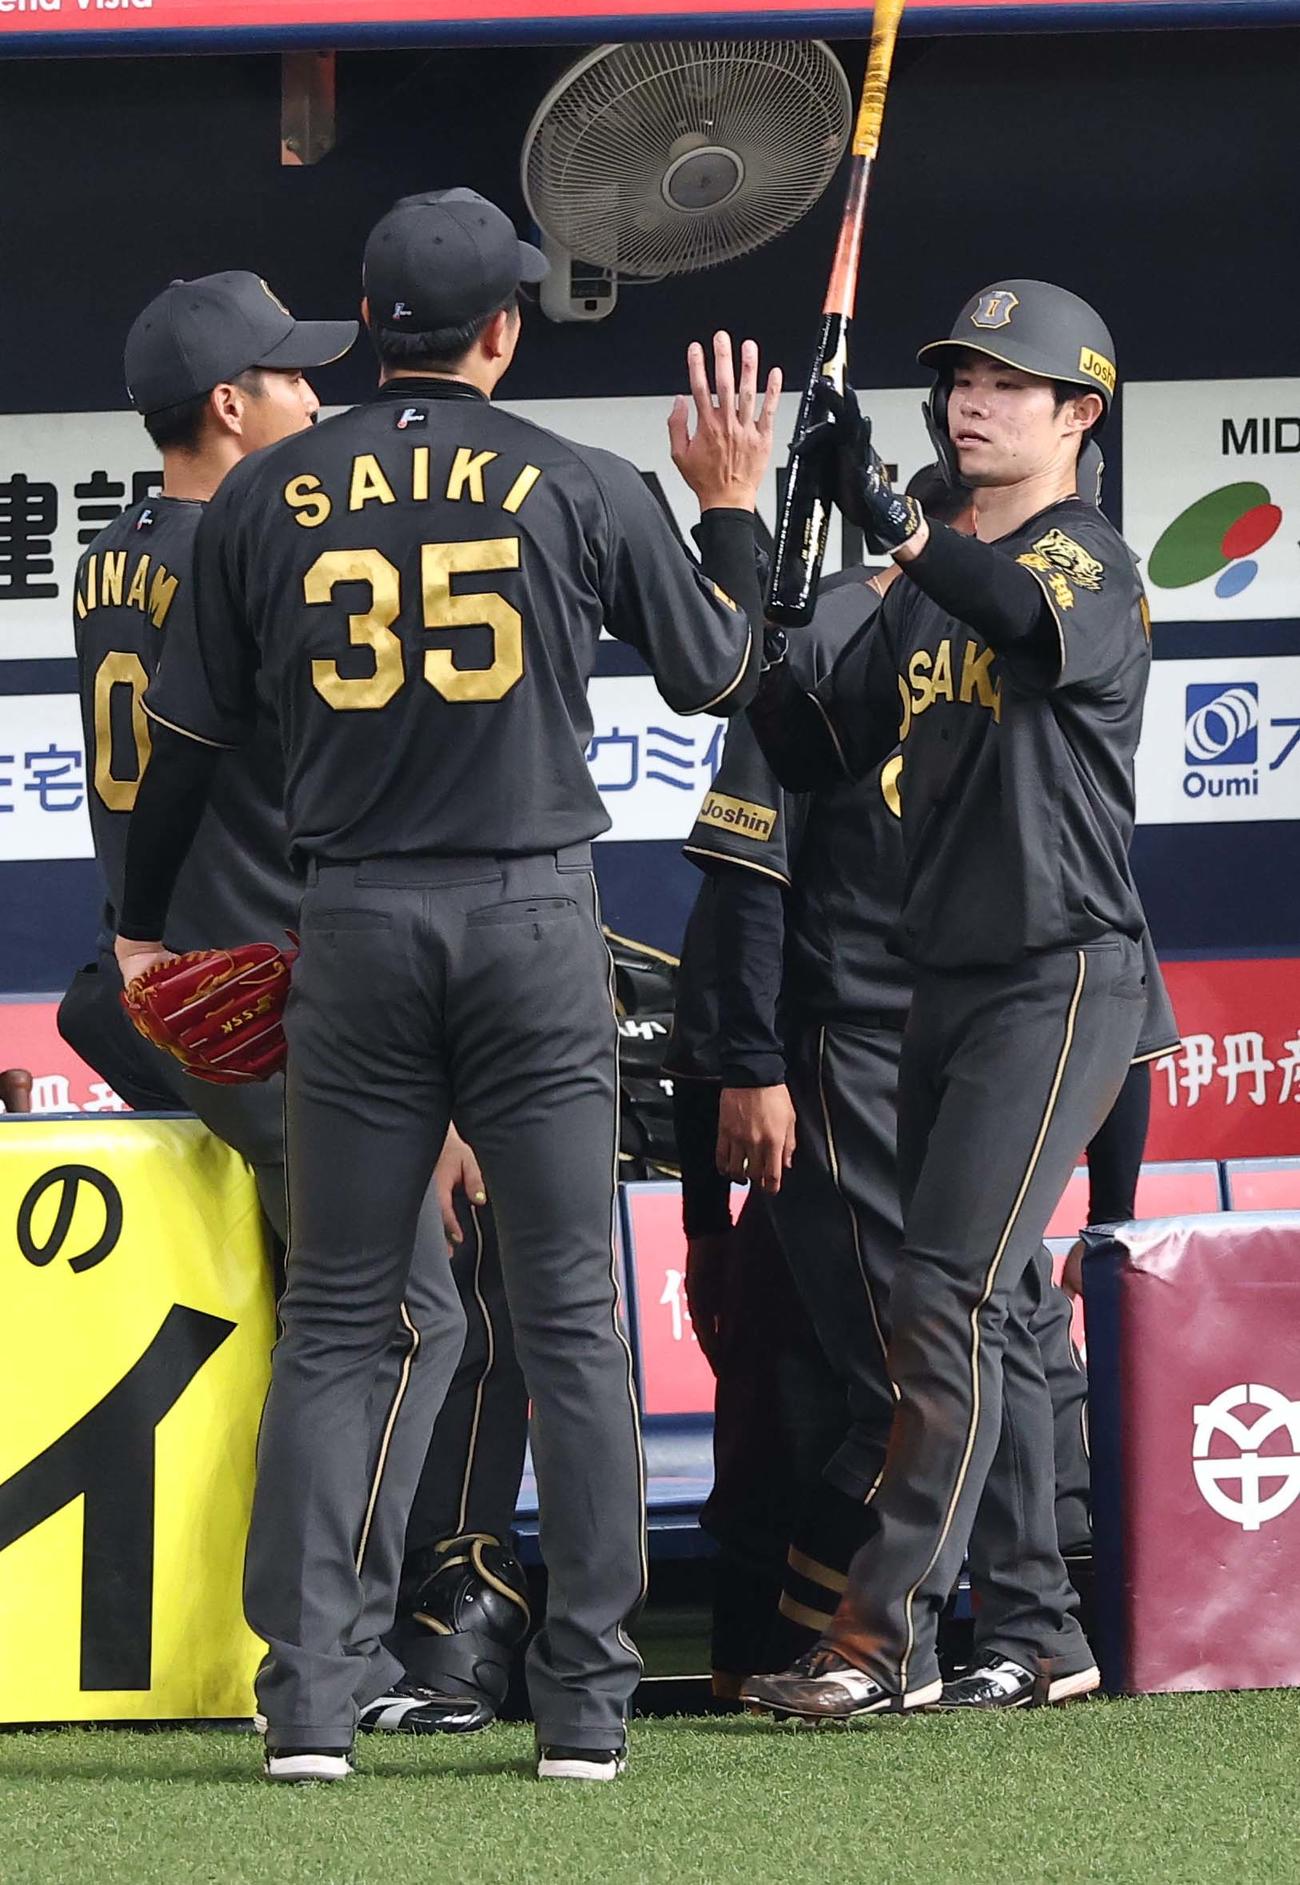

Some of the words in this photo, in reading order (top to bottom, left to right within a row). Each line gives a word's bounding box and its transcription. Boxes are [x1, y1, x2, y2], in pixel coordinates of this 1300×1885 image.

[284, 446, 542, 528] SAIKI
[302, 534, 524, 712] 35
[94, 651, 153, 812] 0
[0, 743, 83, 812] 宅
[701, 799, 770, 835] Joshin
[1183, 769, 1258, 798] Oumi
[17, 1164, 123, 1274] の
